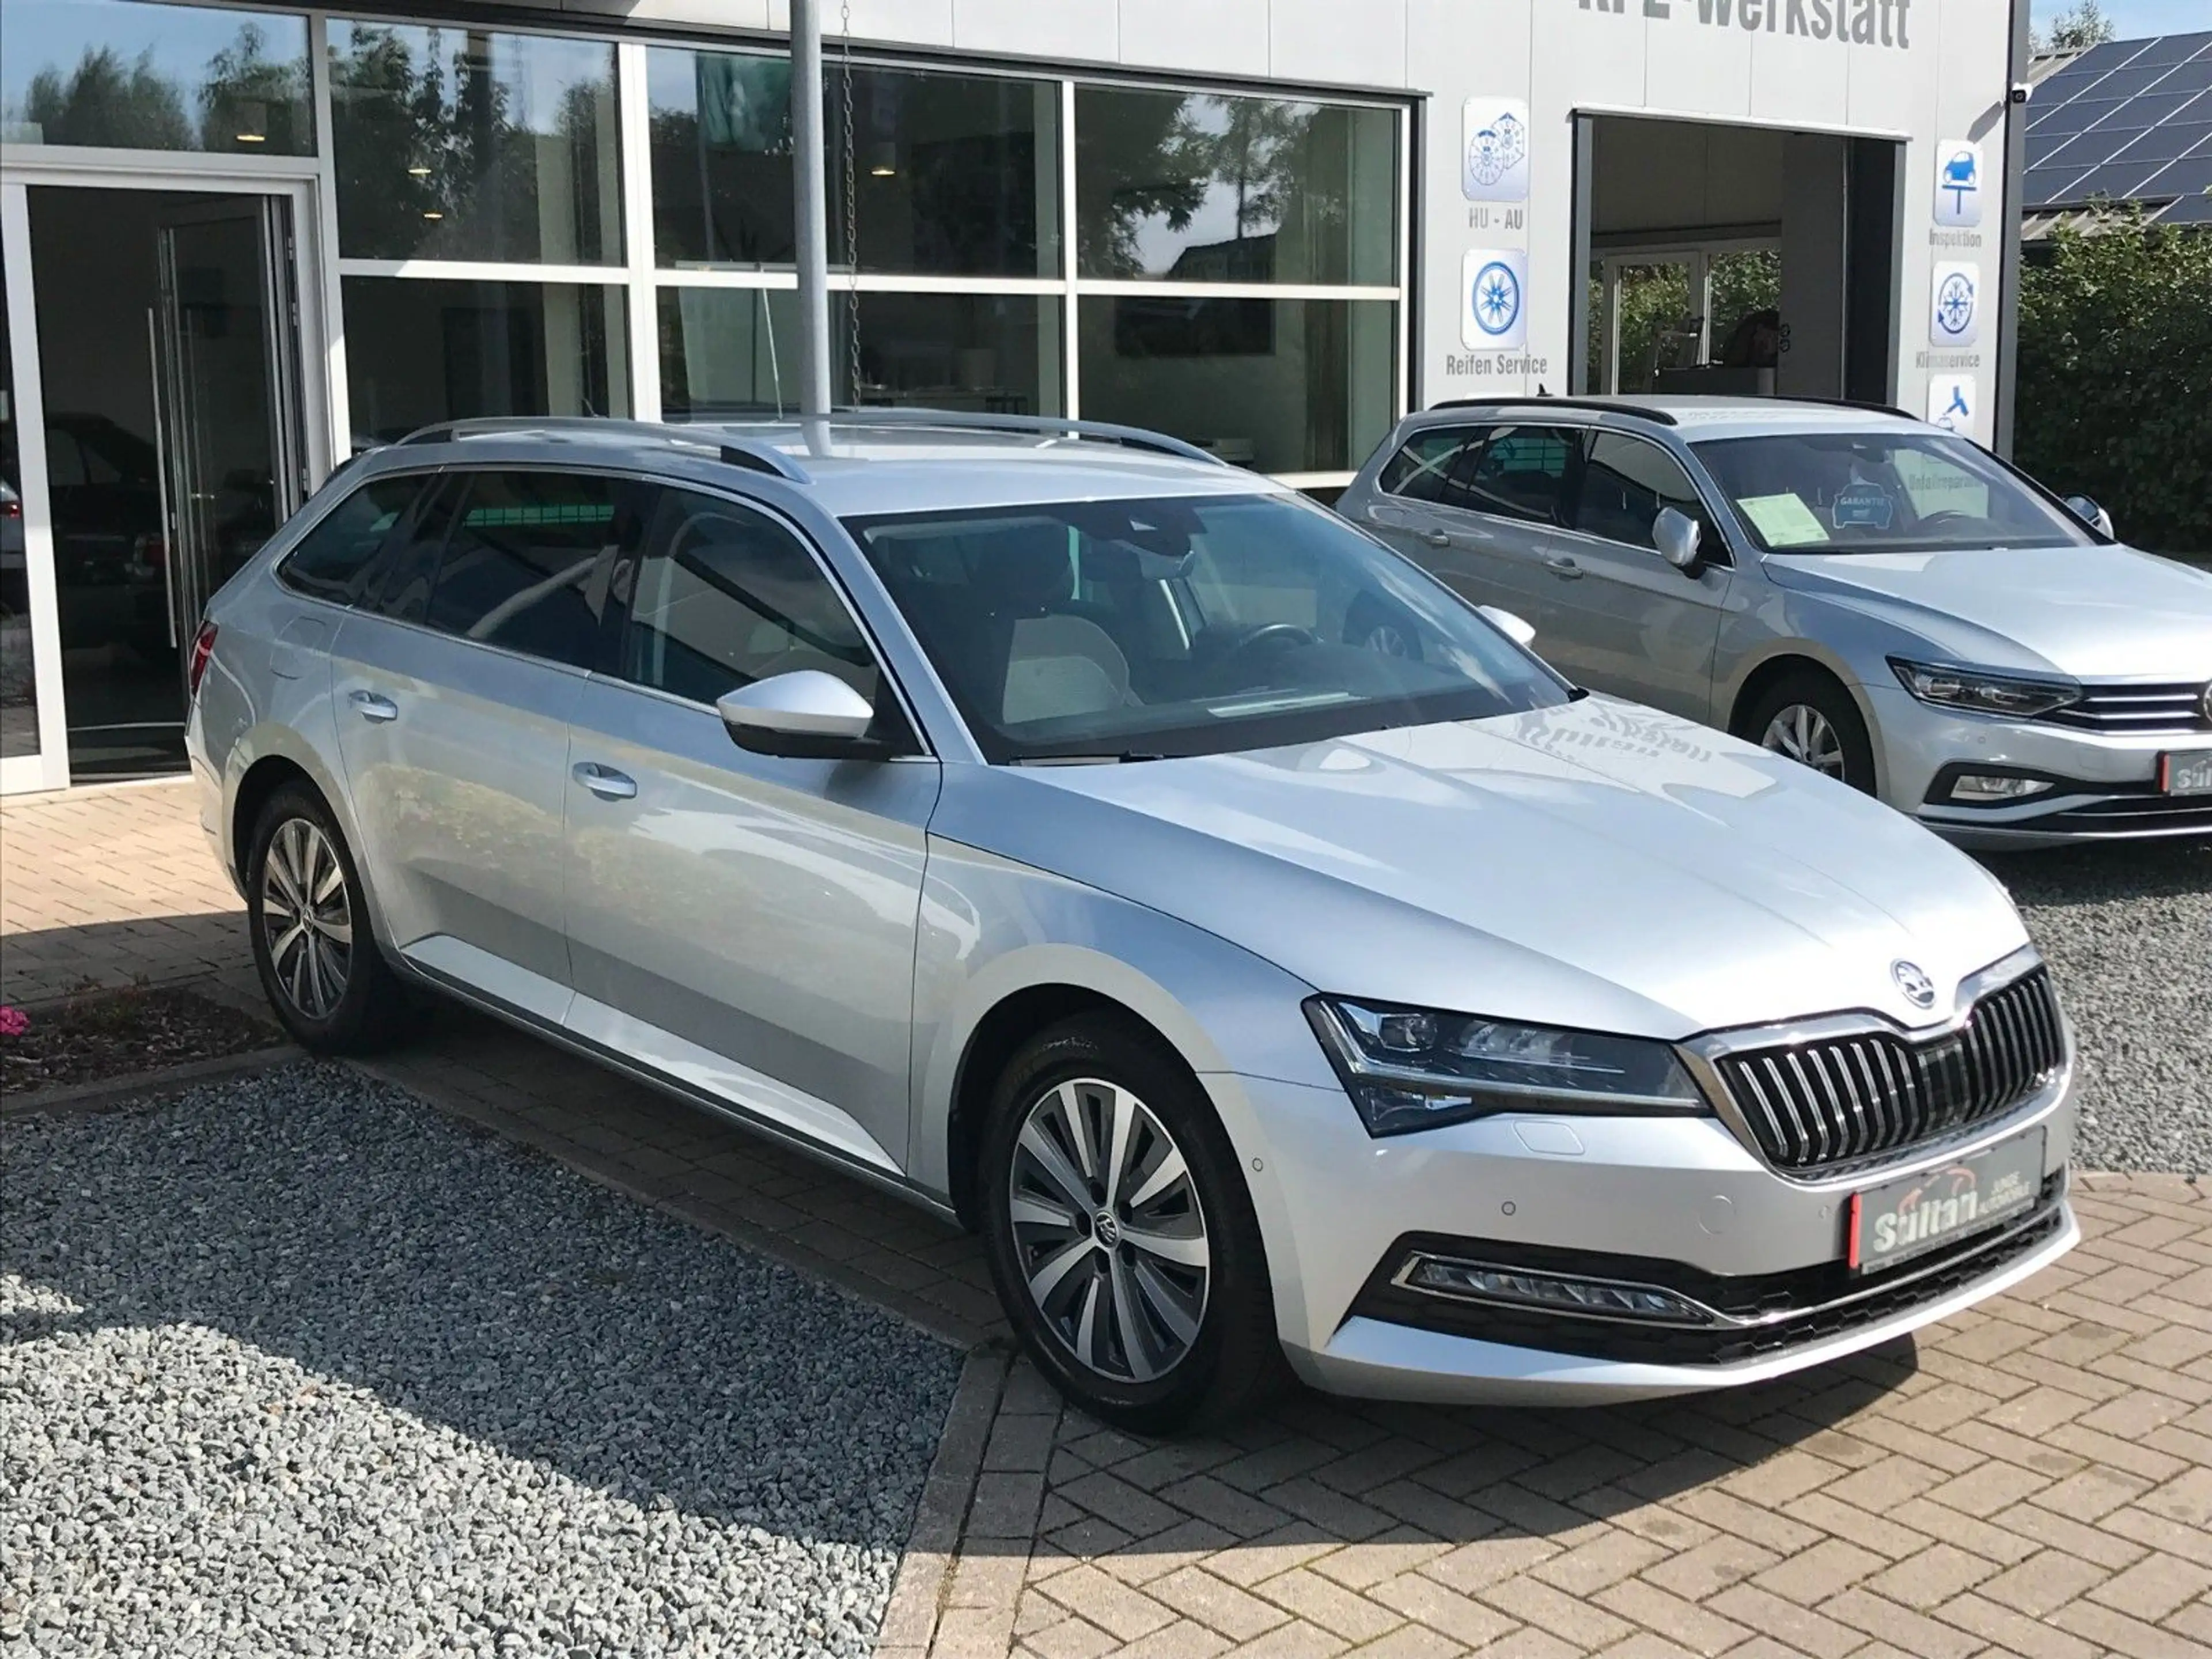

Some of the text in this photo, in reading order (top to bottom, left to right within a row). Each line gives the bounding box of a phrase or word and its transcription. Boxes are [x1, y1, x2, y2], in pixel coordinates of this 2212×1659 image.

[1469, 207, 1488, 229] HU
[1505, 209, 1523, 230] AU
[1446, 354, 1548, 375] Reifen Service
